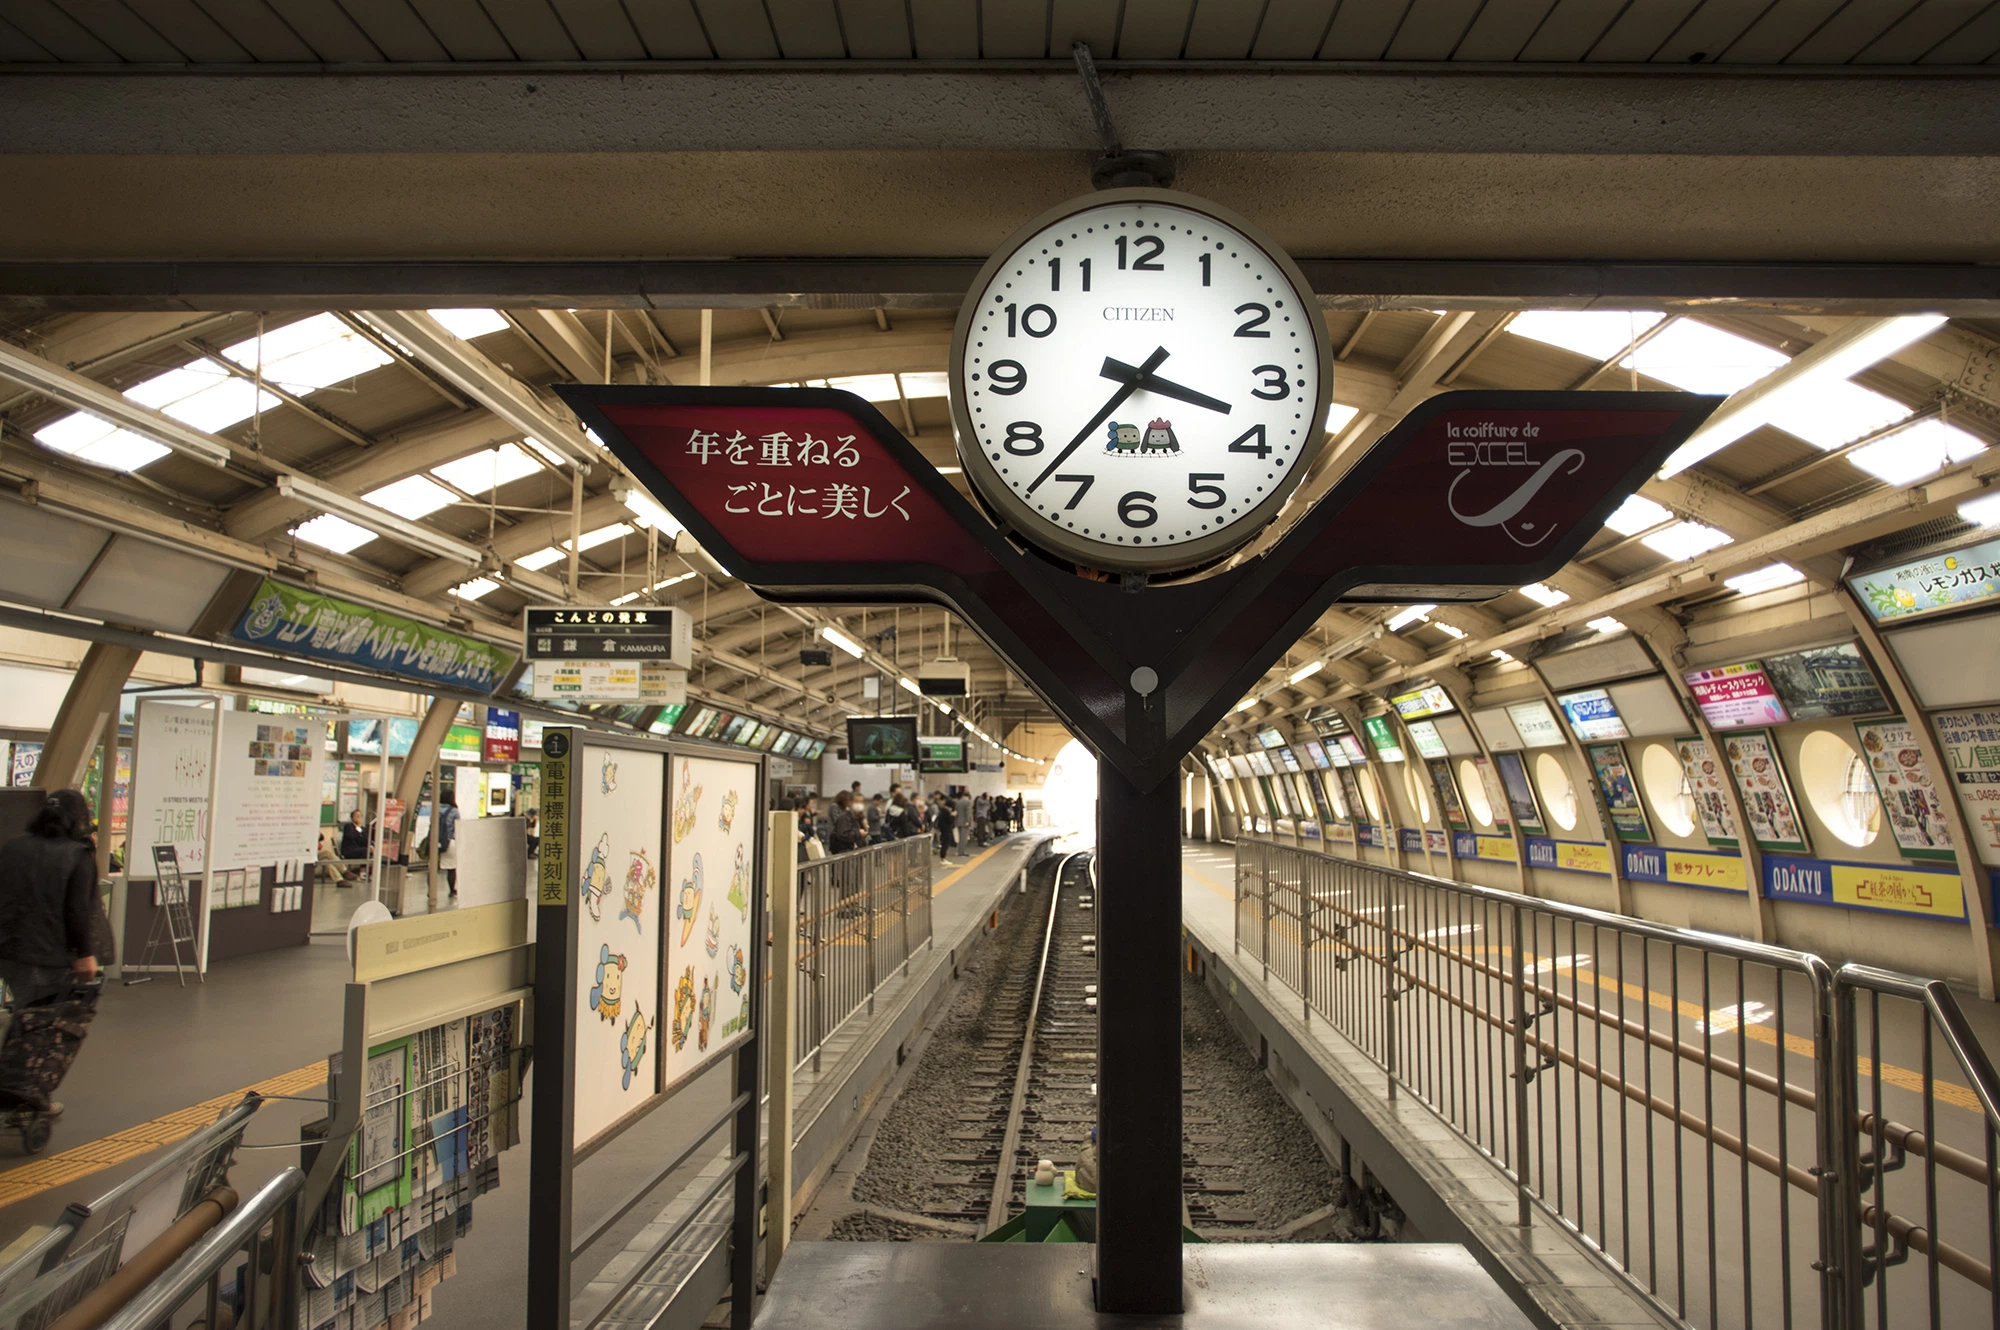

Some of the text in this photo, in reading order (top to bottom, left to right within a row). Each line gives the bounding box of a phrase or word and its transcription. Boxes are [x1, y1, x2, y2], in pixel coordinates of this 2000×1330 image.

[1115, 235, 1165, 271] 12
[1199, 253, 1211, 287] 1
[1048, 257, 1091, 292] 11
[1004, 303, 1057, 338] 10
[1102, 307, 1175, 322] CITIZEN
[1233, 303, 1271, 338] 2
[988, 359, 1027, 396] 9
[1251, 364, 1290, 400] 3
[1003, 421, 1044, 456] 8
[1228, 424, 1272, 459] 4
[1447, 422, 1540, 438] la coiffure de
[685, 429, 860, 467] 年を重ねる
[1448, 442, 1541, 466] EXCEL
[725, 482, 911, 521] ごとに美しく
[1055, 474, 1095, 510] 7
[1187, 473, 1227, 509] 5
[1117, 491, 1158, 528] 6
[555, 612, 647, 624] こんどの発車
[563, 639, 617, 652] 鎌倉
[620, 645, 666, 653] KAMAKURA
[543, 761, 565, 900] 電車標準時刻表
[1627, 852, 1660, 876] ODAKYU
[1773, 864, 1822, 896] ODAKYU
[1870, 880, 1917, 902] 紅茶の国から
